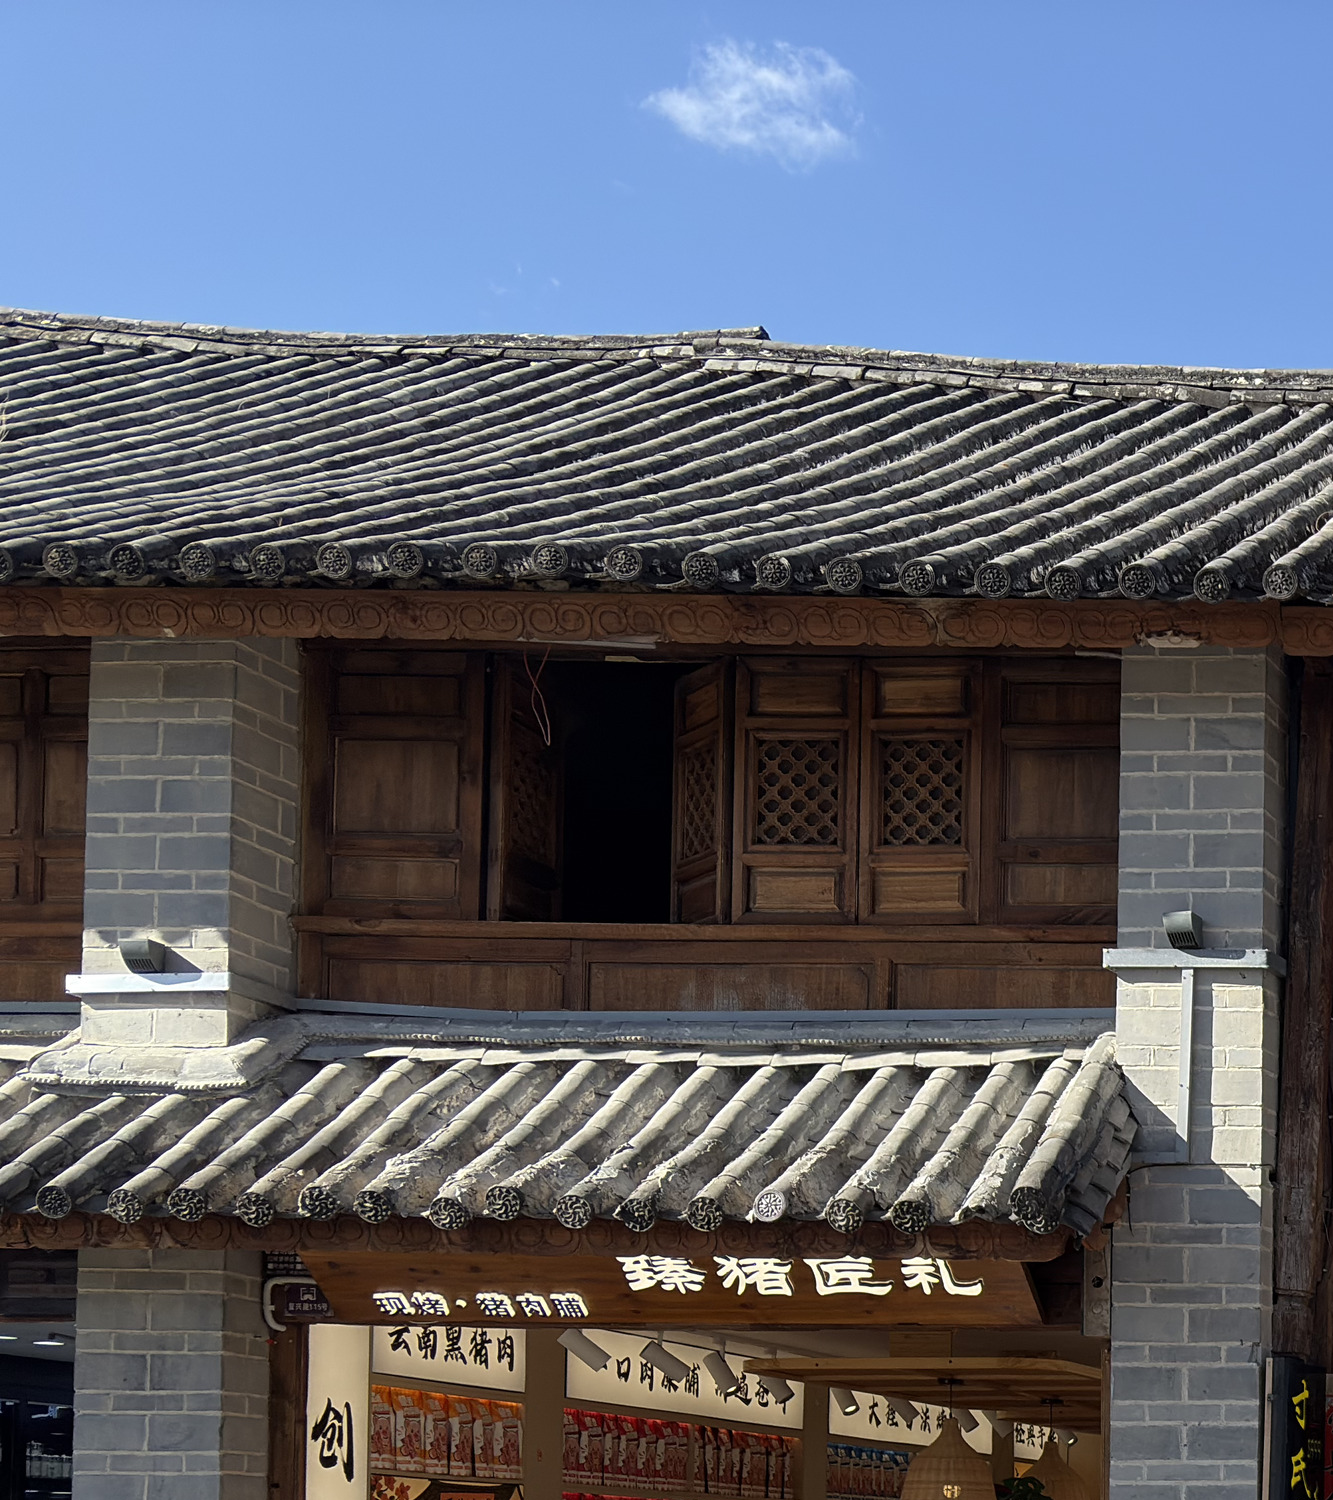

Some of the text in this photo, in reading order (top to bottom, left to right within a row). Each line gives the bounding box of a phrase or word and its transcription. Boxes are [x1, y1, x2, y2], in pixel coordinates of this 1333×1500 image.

[615, 1255, 985, 1297] 臻猪匠礼
[387, 1326, 516, 1372] 云南黑猪肉
